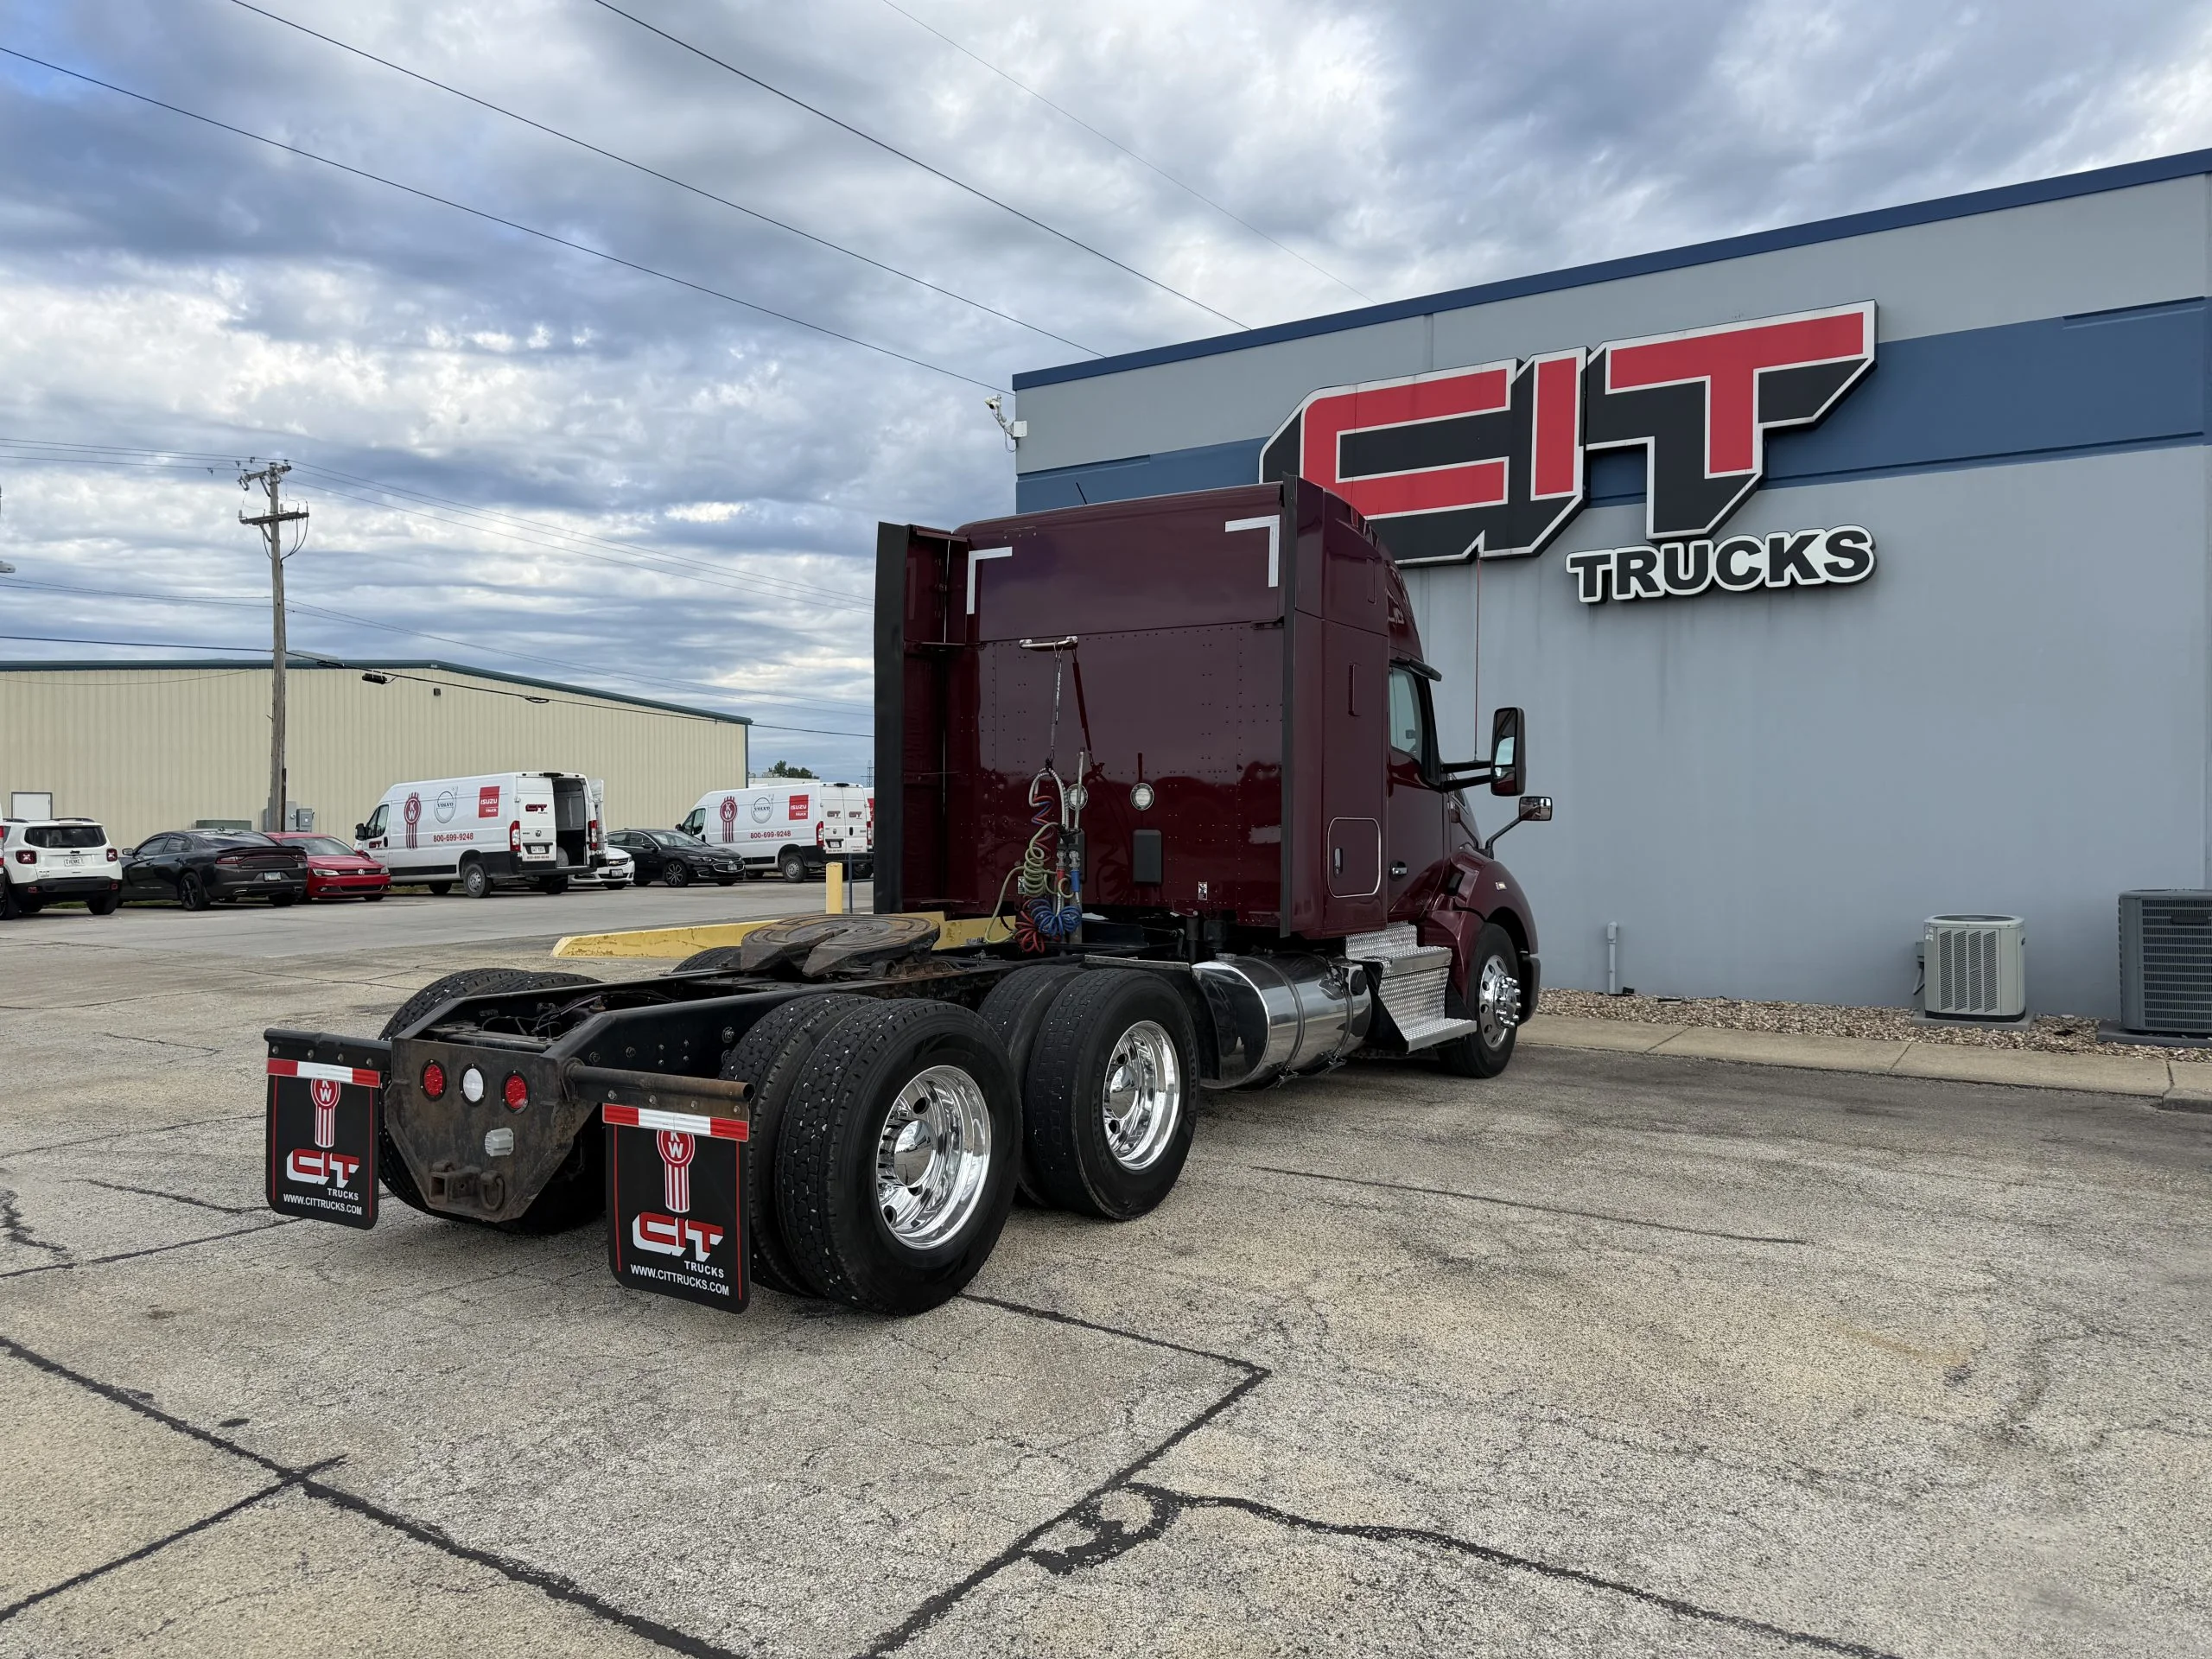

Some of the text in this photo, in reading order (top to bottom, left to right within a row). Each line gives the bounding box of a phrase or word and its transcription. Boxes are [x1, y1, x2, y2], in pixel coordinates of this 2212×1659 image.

[1260, 300, 1877, 567] CIT
[1567, 526, 1873, 602] TRUCKS
[433, 832, 474, 842] 800-699-9248
[750, 830, 791, 839] 800-699-9248
[286, 1147, 360, 1189] CIT
[283, 1193, 363, 1216] WWW.CITTRUCKS.COM
[327, 1187, 359, 1201] TRUCKS
[632, 1211, 724, 1262] CIT
[630, 1263, 730, 1297] WWW.CITTRUCKS.COM
[683, 1260, 725, 1279] TRUCKS
